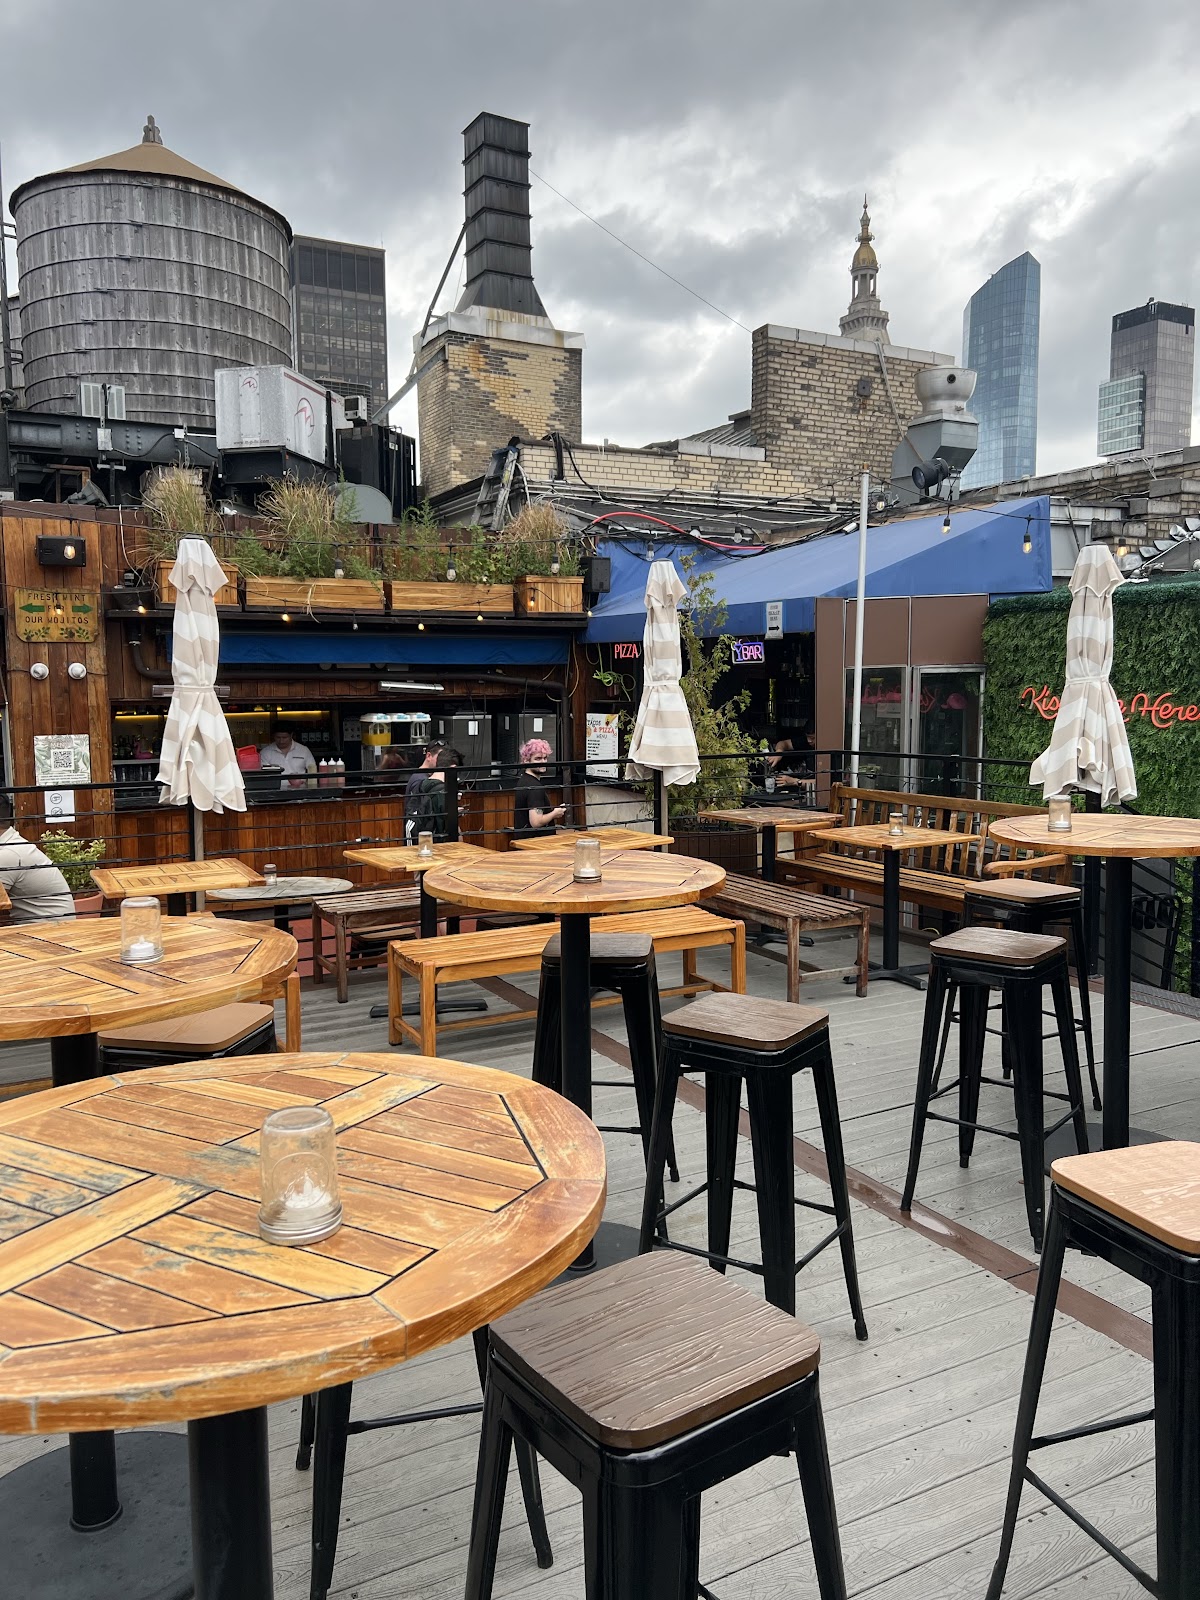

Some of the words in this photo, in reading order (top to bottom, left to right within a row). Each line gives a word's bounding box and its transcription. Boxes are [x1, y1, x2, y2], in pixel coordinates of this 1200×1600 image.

[62, 594, 86, 602] MINT
[25, 615, 43, 624] OUR
[47, 616, 89, 624] MOJITOS
[614, 643, 639, 659] PIZZA
[741, 644, 763, 661] BAR
[1021, 684, 1061, 720] Kis
[1131, 692, 1200, 729] Here
[598, 726, 615, 734] PIZZA
